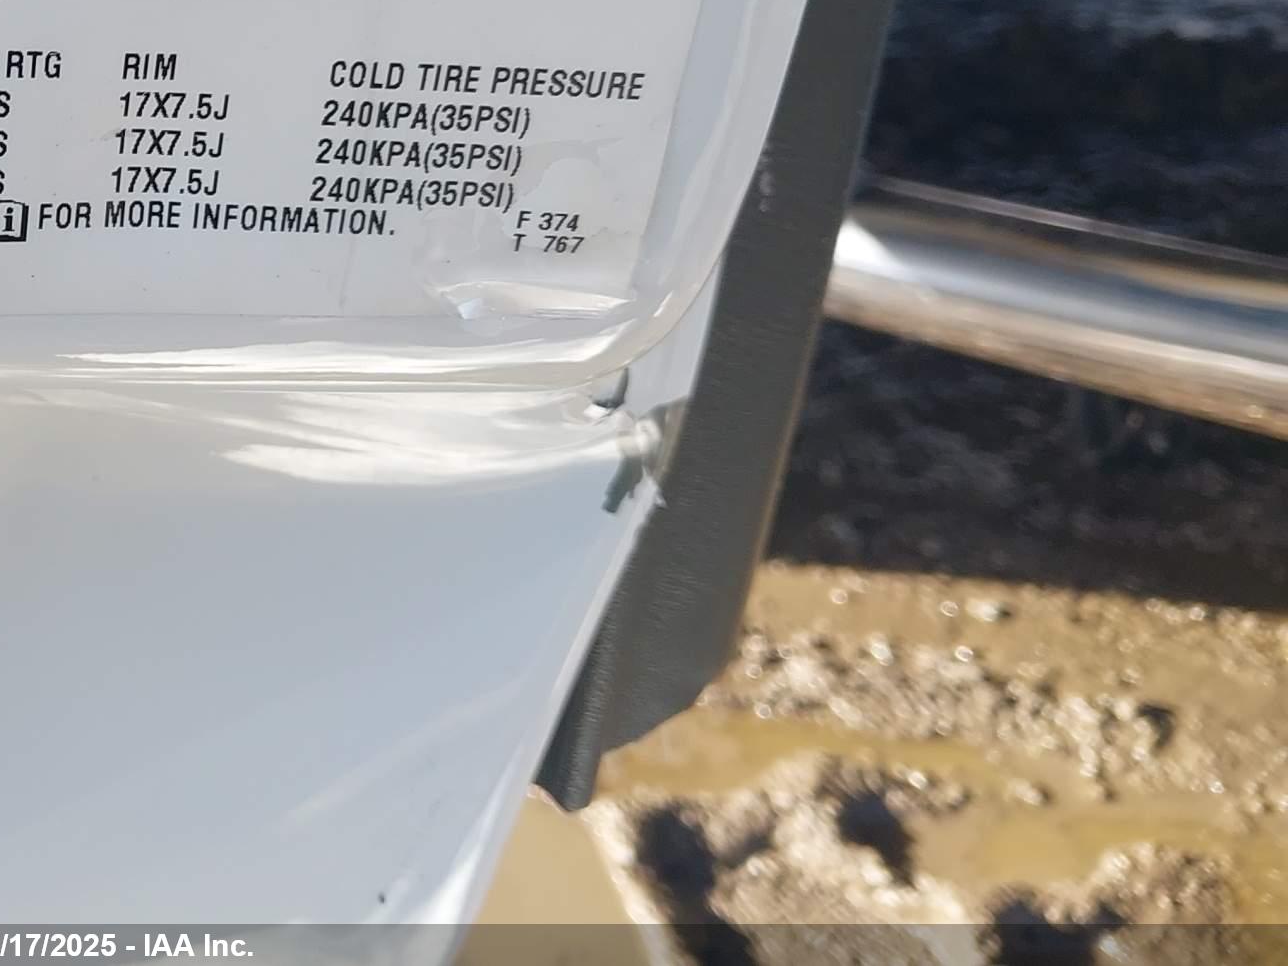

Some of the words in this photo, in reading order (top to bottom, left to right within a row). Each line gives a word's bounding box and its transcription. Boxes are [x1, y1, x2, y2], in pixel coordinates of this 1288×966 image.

[6, 50, 61, 78] RTG
[122, 53, 177, 80] RIM
[330, 61, 405, 89] COLD
[418, 64, 481, 93] TIRE
[491, 67, 645, 100] PRESSURE
[120, 91, 229, 120] 17X7.5J
[321, 100, 530, 139] 240KPA(35PSI)
[115, 128, 224, 158] 17X7.5J
[315, 138, 522, 177] 240KPA(35PSI)
[112, 166, 219, 196] 17X7.5J
[308, 176, 514, 214] 240KPA(35PSI)
[38, 202, 91, 229] FOR
[104, 200, 181, 228] MORE
[193, 203, 394, 235] INFORMATION.
[517, 211, 532, 229] F
[538, 213, 580, 232] 374
[513, 234, 527, 252] T
[543, 236, 585, 253] 767
